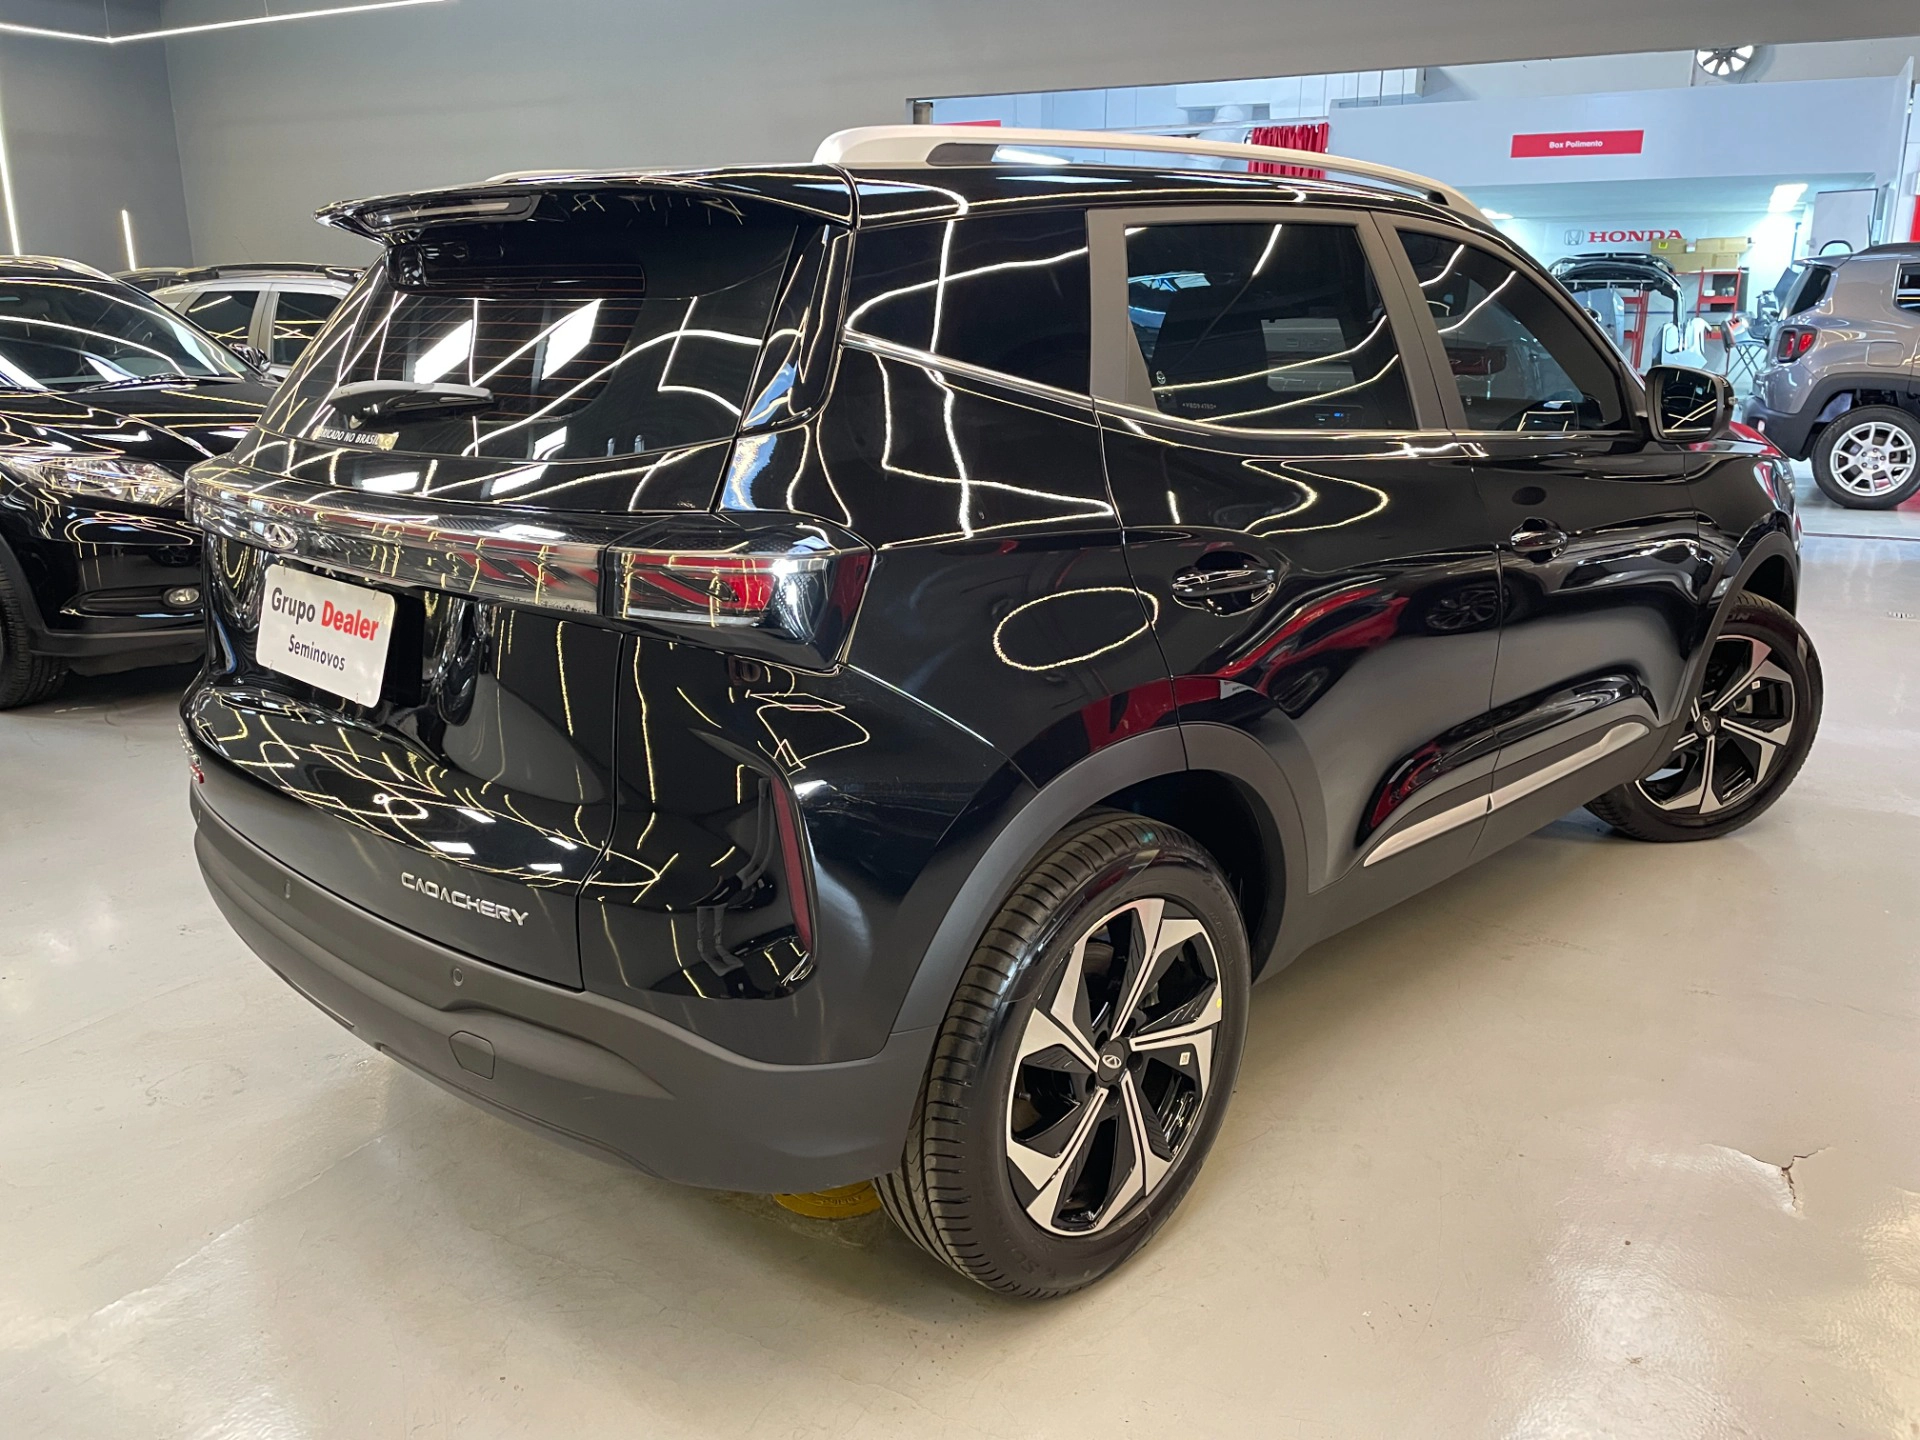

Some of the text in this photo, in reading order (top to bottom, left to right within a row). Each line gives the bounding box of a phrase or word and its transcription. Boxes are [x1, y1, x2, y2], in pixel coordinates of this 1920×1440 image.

[1549, 140, 1603, 149] Box Polimento
[1587, 230, 1683, 243] HONDA
[343, 431, 356, 443] NO
[271, 587, 379, 641] Grupo Dealer
[288, 634, 346, 671] Seminovos
[401, 871, 529, 926] CAOACHERY
